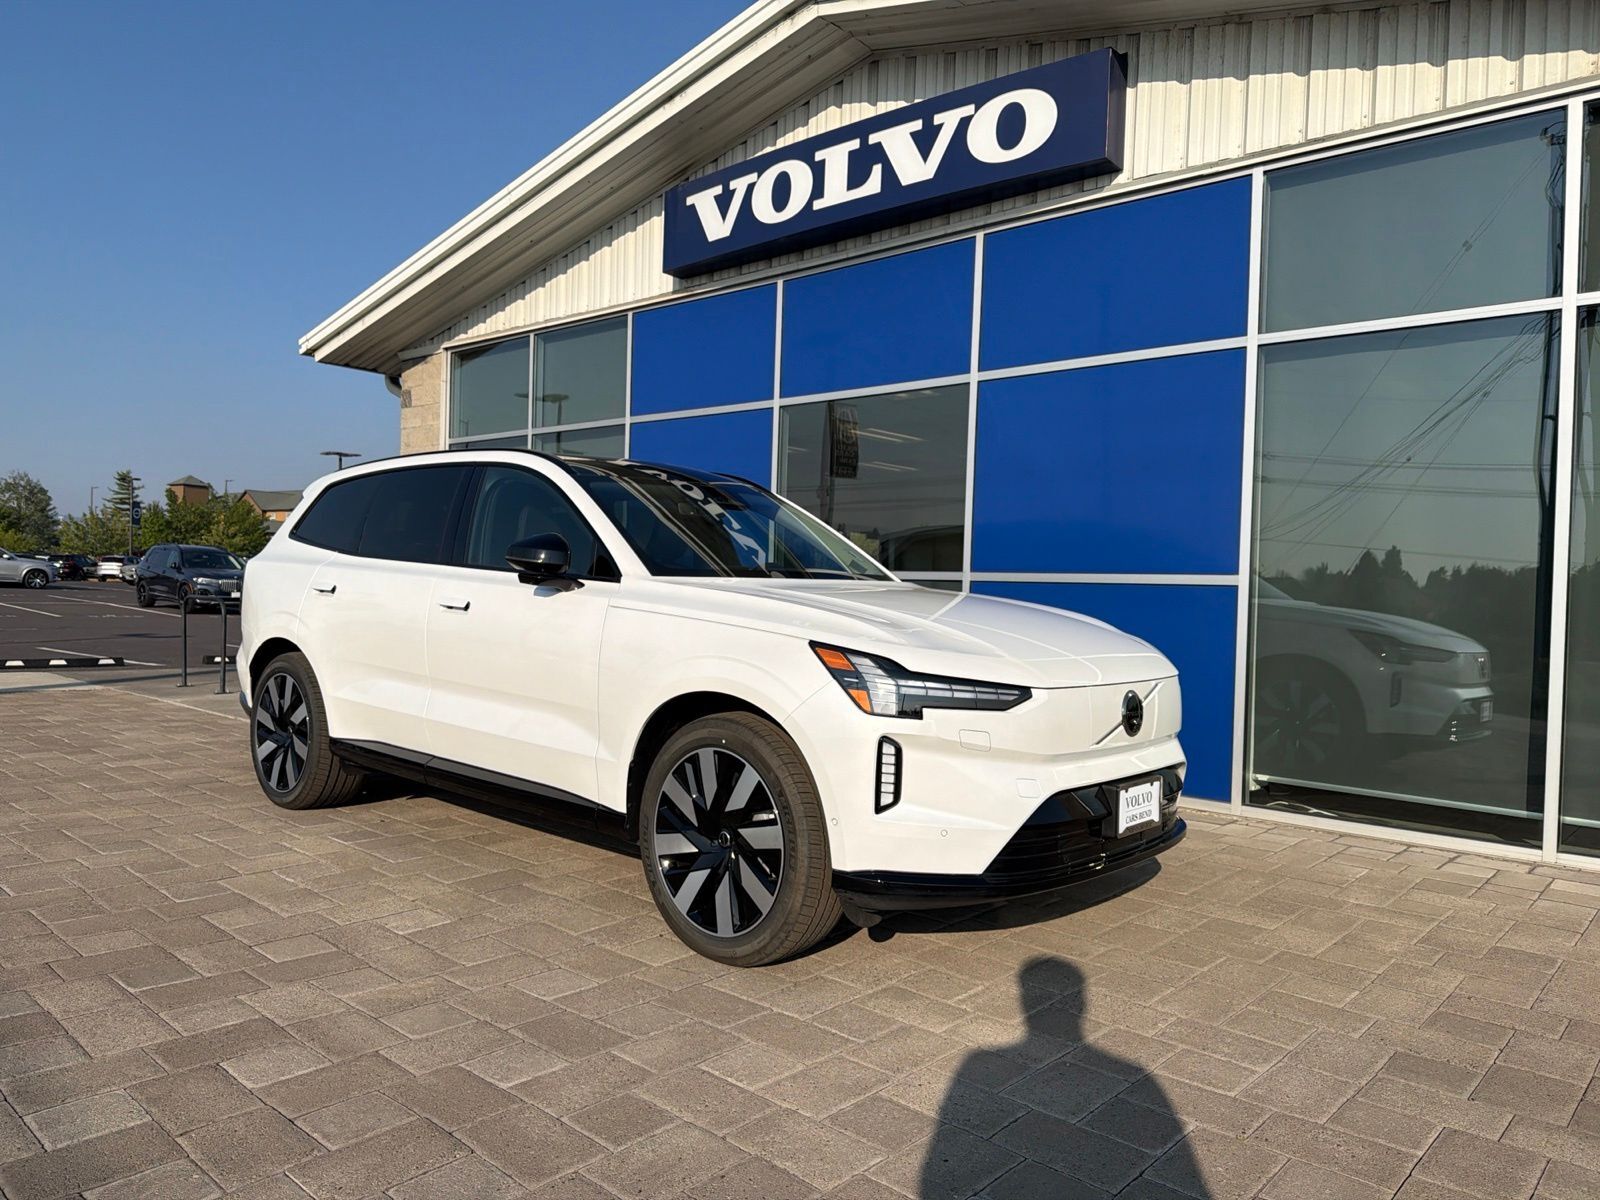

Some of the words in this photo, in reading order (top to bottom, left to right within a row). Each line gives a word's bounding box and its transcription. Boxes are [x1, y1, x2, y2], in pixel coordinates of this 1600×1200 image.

[686, 88, 1058, 243] VOLVO
[1125, 790, 1153, 809] VOLVO
[1125, 813, 1138, 824] CARS
[1138, 809, 1152, 820] BEND
